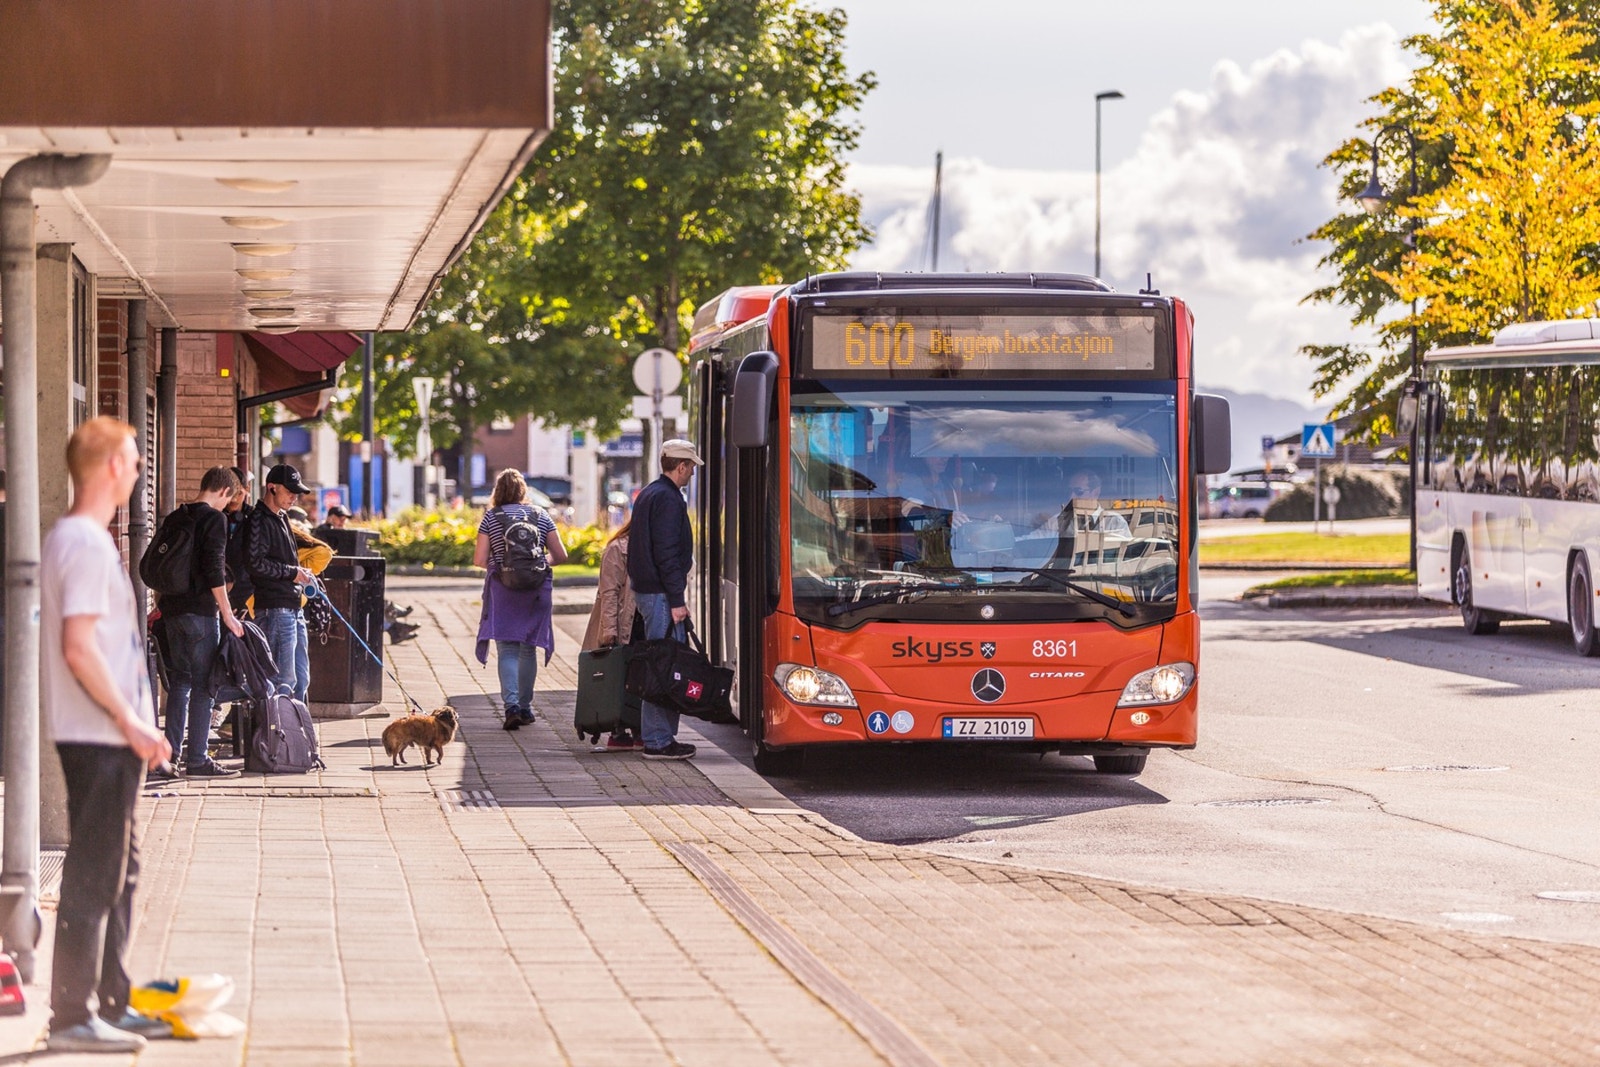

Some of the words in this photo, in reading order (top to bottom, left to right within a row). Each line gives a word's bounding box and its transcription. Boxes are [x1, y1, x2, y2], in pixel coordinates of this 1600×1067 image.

[844, 322, 915, 366] 600
[929, 329, 999, 360] Bergen
[1004, 330, 1114, 361] busstasjon
[892, 636, 974, 663] skyss
[1032, 640, 1077, 658] 8361
[959, 721, 977, 735] ZZ
[983, 721, 1027, 735] 21019
